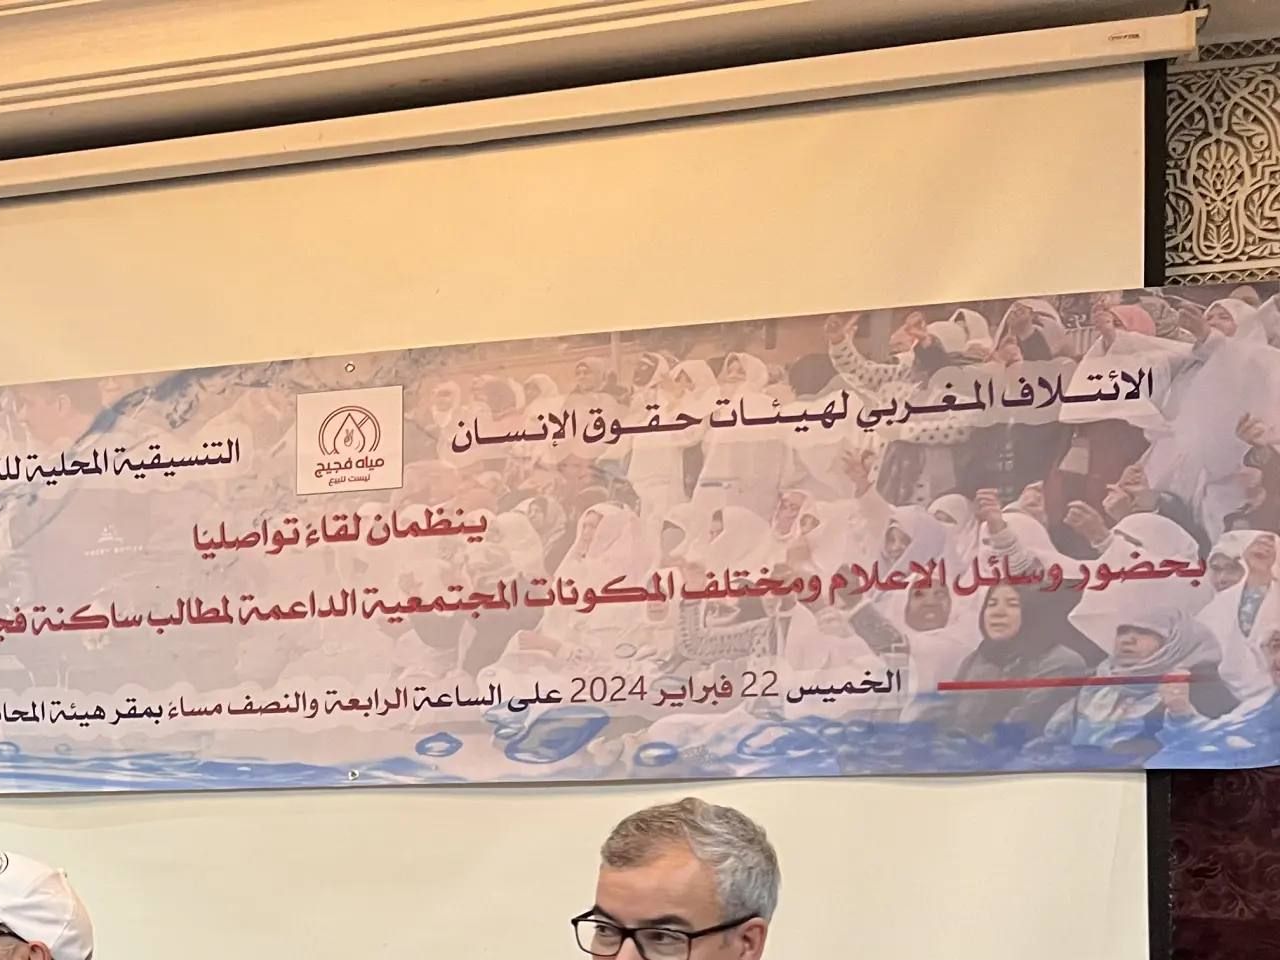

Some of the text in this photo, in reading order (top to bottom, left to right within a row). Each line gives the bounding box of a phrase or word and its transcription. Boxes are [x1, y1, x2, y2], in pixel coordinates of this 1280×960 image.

[451, 367, 1154, 453] الائتلاف المغربي لهيئات حقوق الإنسان
[26, 449, 108, 486] المحلية
[115, 437, 240, 478] التنسيقية
[314, 456, 385, 478] مياه فجيج
[366, 507, 488, 546] ينظمان
[680, 565, 821, 604] ومختلف
[828, 557, 946, 606] الإعلام
[952, 555, 1062, 596] وسائل
[1072, 552, 1207, 593] بحضور
[238, 588, 357, 625] الداعمة
[361, 579, 517, 624] المجتمعية
[524, 570, 675, 614] المكونات
[31, 602, 143, 637] ساكنة
[147, 596, 234, 636] لمطالب
[413, 682, 502, 707] الساعة
[507, 682, 562, 712] على
[571, 675, 647, 702] 2024
[653, 675, 733, 707] فبراير
[740, 671, 779, 697] 22
[785, 670, 901, 706] الخميس
[50, 700, 106, 727] هيئة
[109, 698, 163, 726] بمقر
[227, 691, 319, 720] والنصف
[326, 687, 408, 719] الرابعة
